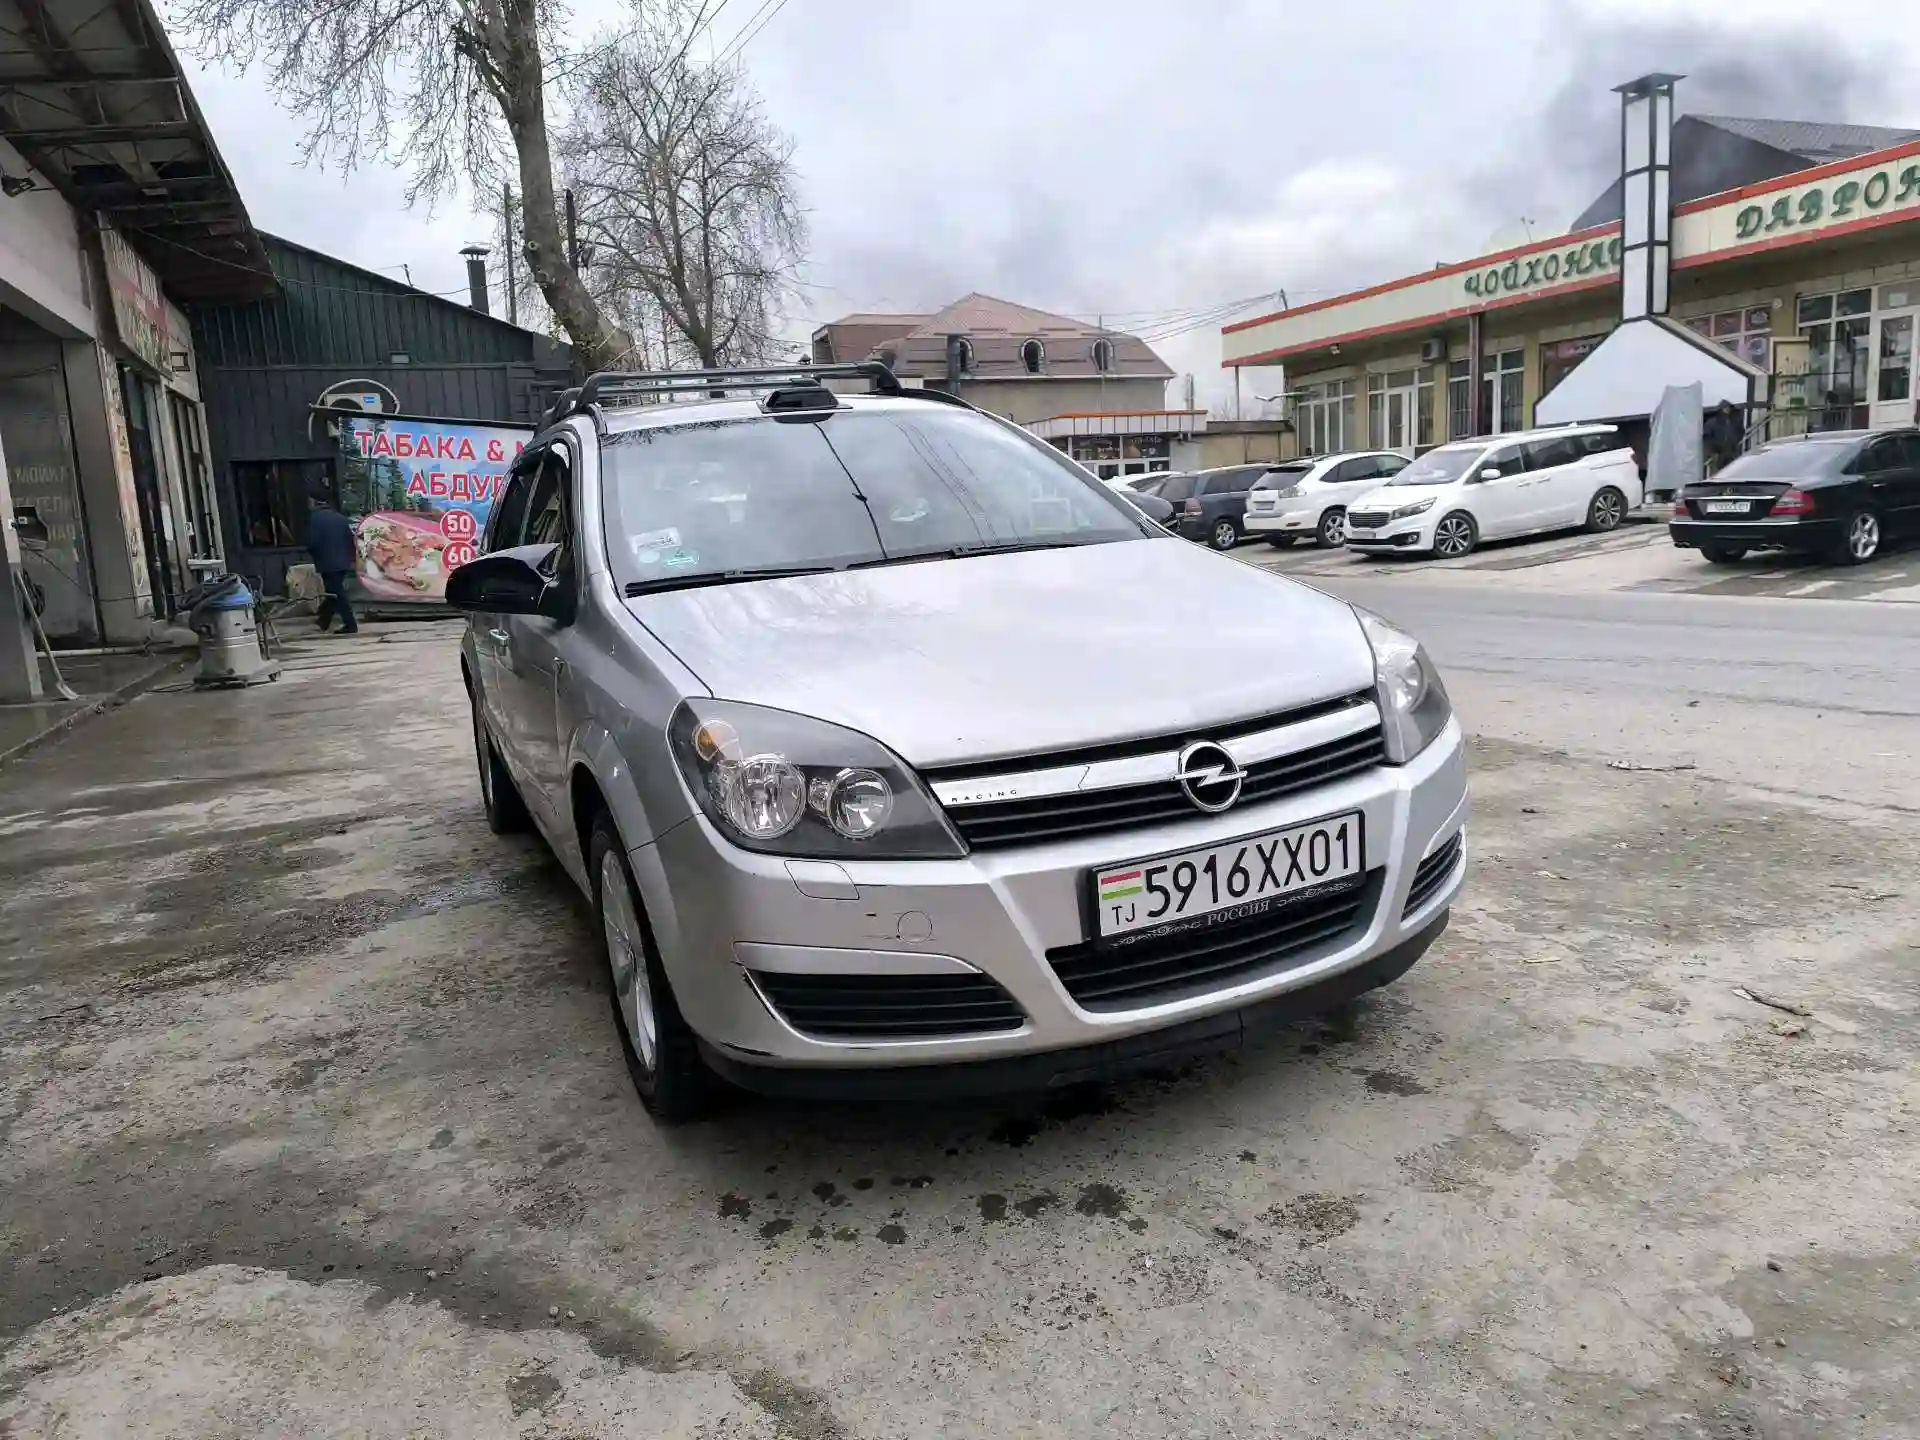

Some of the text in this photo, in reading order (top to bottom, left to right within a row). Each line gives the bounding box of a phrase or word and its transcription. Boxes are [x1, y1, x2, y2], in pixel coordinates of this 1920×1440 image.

[354, 431, 477, 461] ТАБАКА
[486, 439, 505, 462] &
[447, 514, 471, 533] 50
[447, 546, 472, 564] 60
[951, 787, 1018, 803] RACING
[1144, 822, 1349, 918] 5916XX01
[1111, 902, 1136, 926] TJ
[1207, 900, 1269, 926] РОССИЯ
